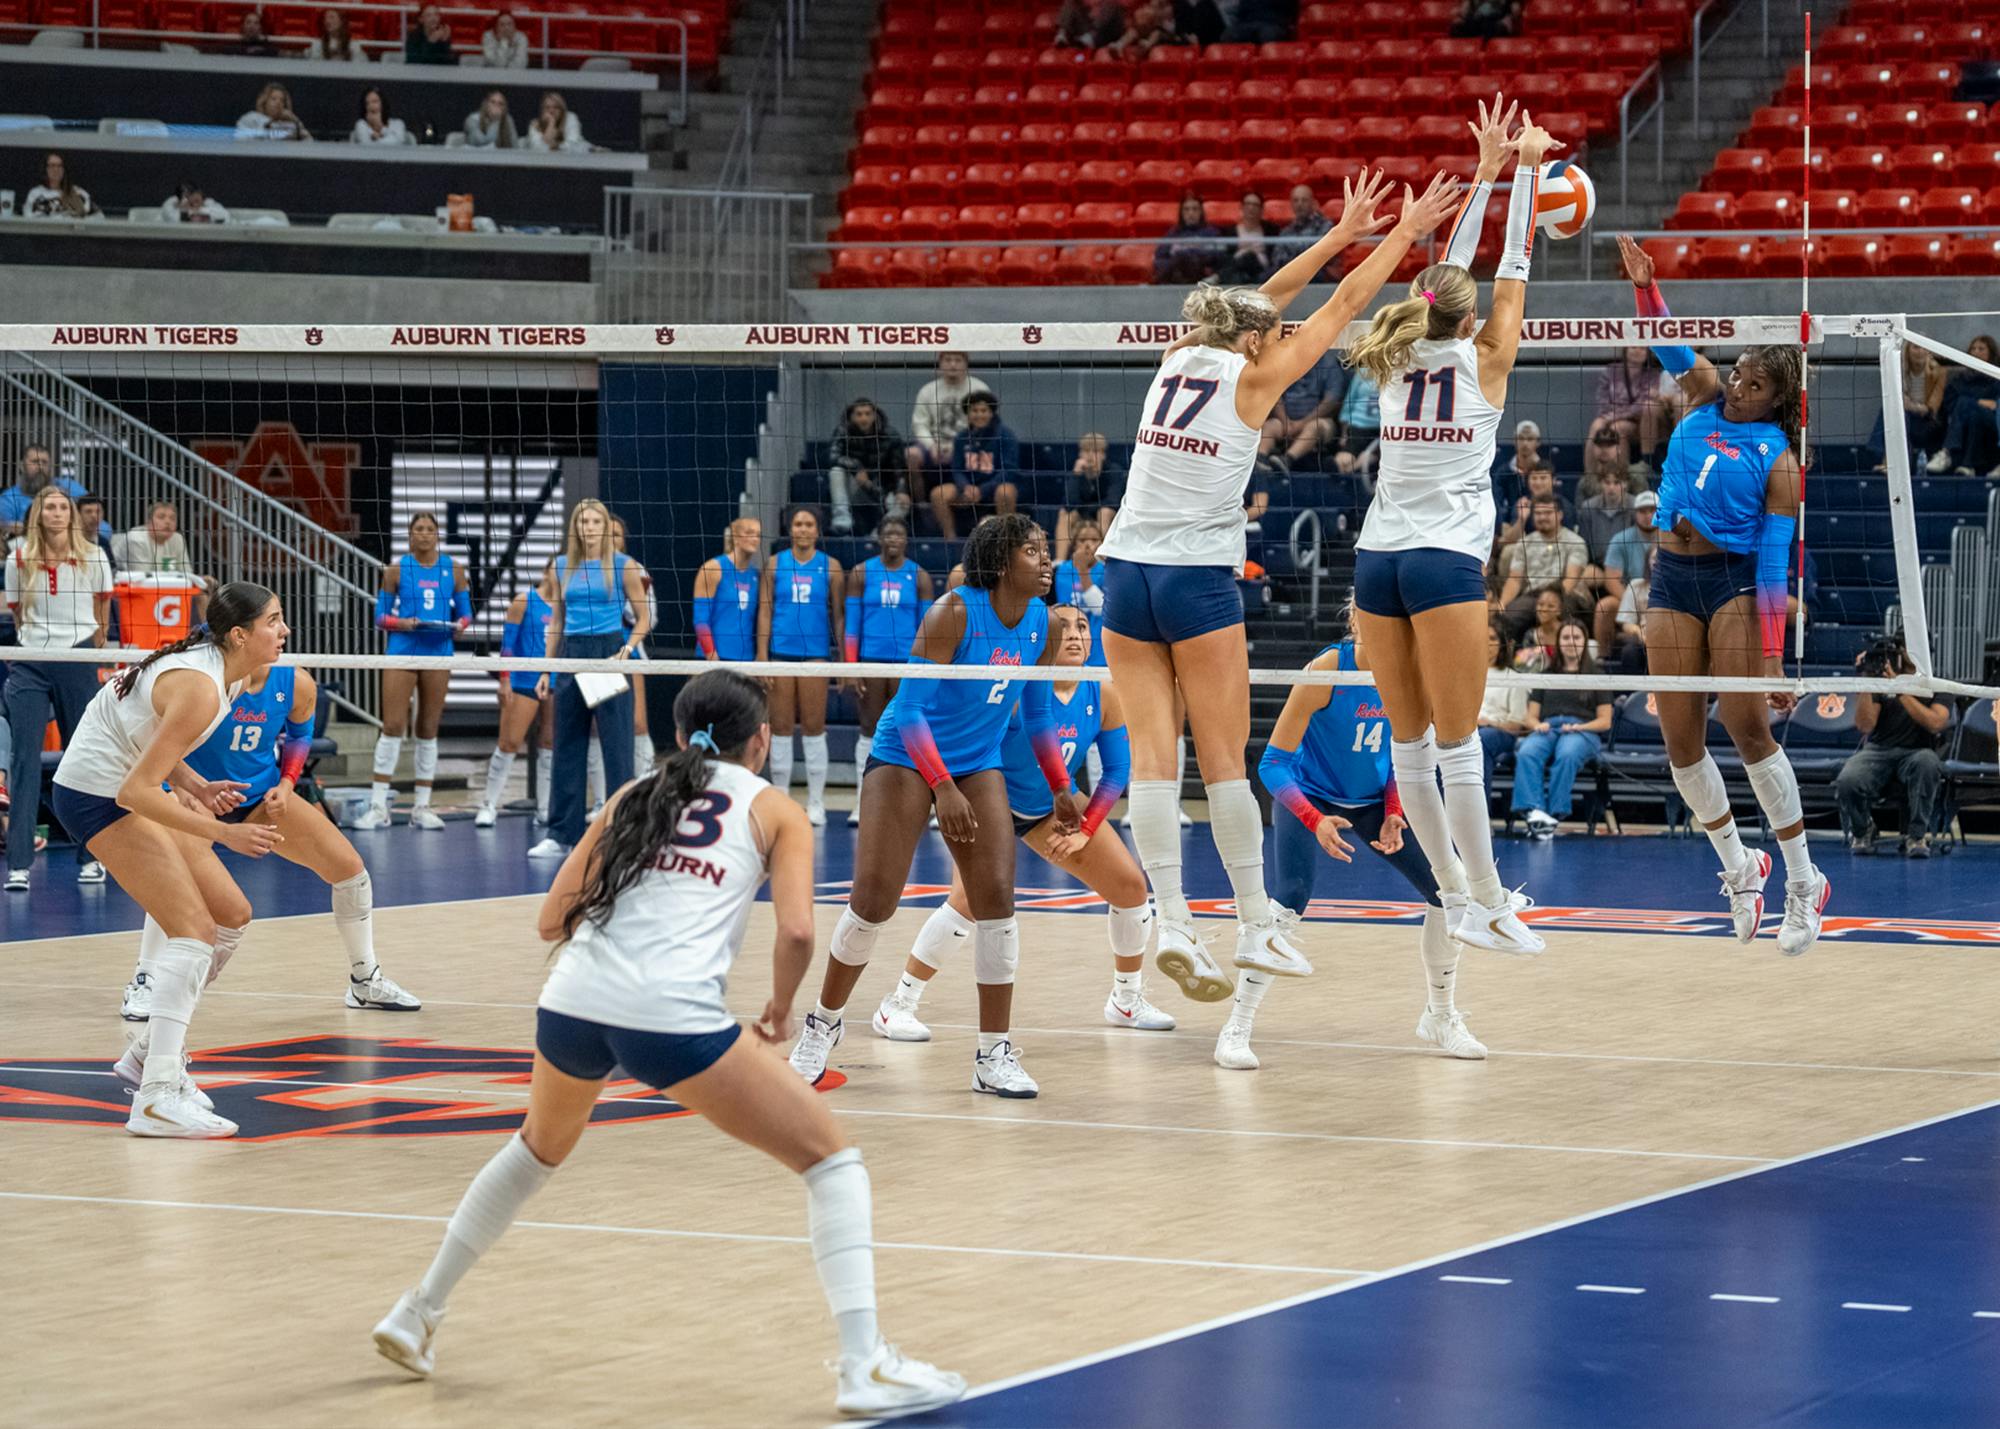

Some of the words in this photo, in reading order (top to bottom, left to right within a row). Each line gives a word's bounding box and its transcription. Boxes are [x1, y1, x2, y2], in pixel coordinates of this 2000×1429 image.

[52, 327, 147, 345] AUBURN
[154, 327, 239, 345] TIGERS
[391, 327, 490, 345] AUBURN
[498, 327, 586, 345] TIGERS
[745, 326, 850, 344] AUBURN
[857, 326, 949, 344] TIGERS
[1632, 319, 1735, 339] TIGERS
[1151, 373, 1220, 431] 17
[1403, 366, 1456, 422] 11
[1381, 425, 1474, 443] AUBURN
[1694, 453, 1718, 490] 1
[423, 588, 435, 611] 9
[791, 584, 812, 604] 12
[153, 595, 181, 627] G
[986, 678, 1010, 704] 2
[229, 725, 263, 751] 13
[1352, 721, 1384, 753] 14
